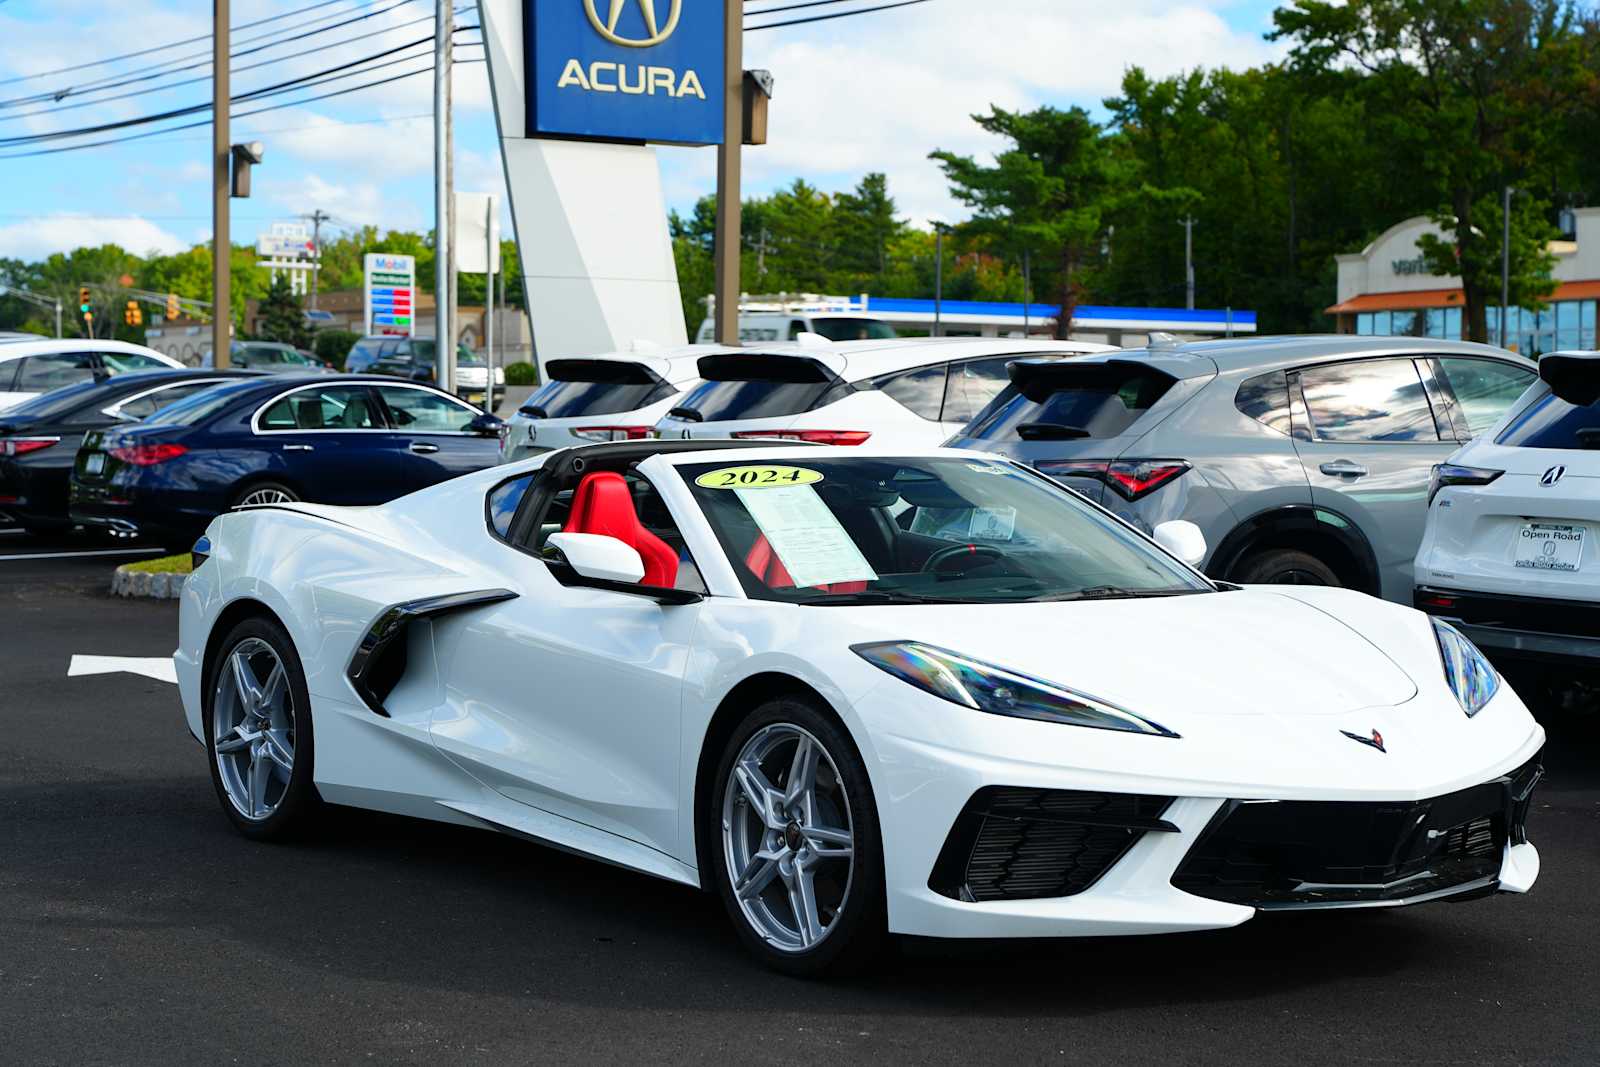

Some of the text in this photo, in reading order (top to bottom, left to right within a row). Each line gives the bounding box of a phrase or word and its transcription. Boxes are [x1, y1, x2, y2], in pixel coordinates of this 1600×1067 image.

[557, 59, 706, 99] ACURA
[721, 469, 801, 486] 2024
[1522, 529, 1581, 541] Open Road
